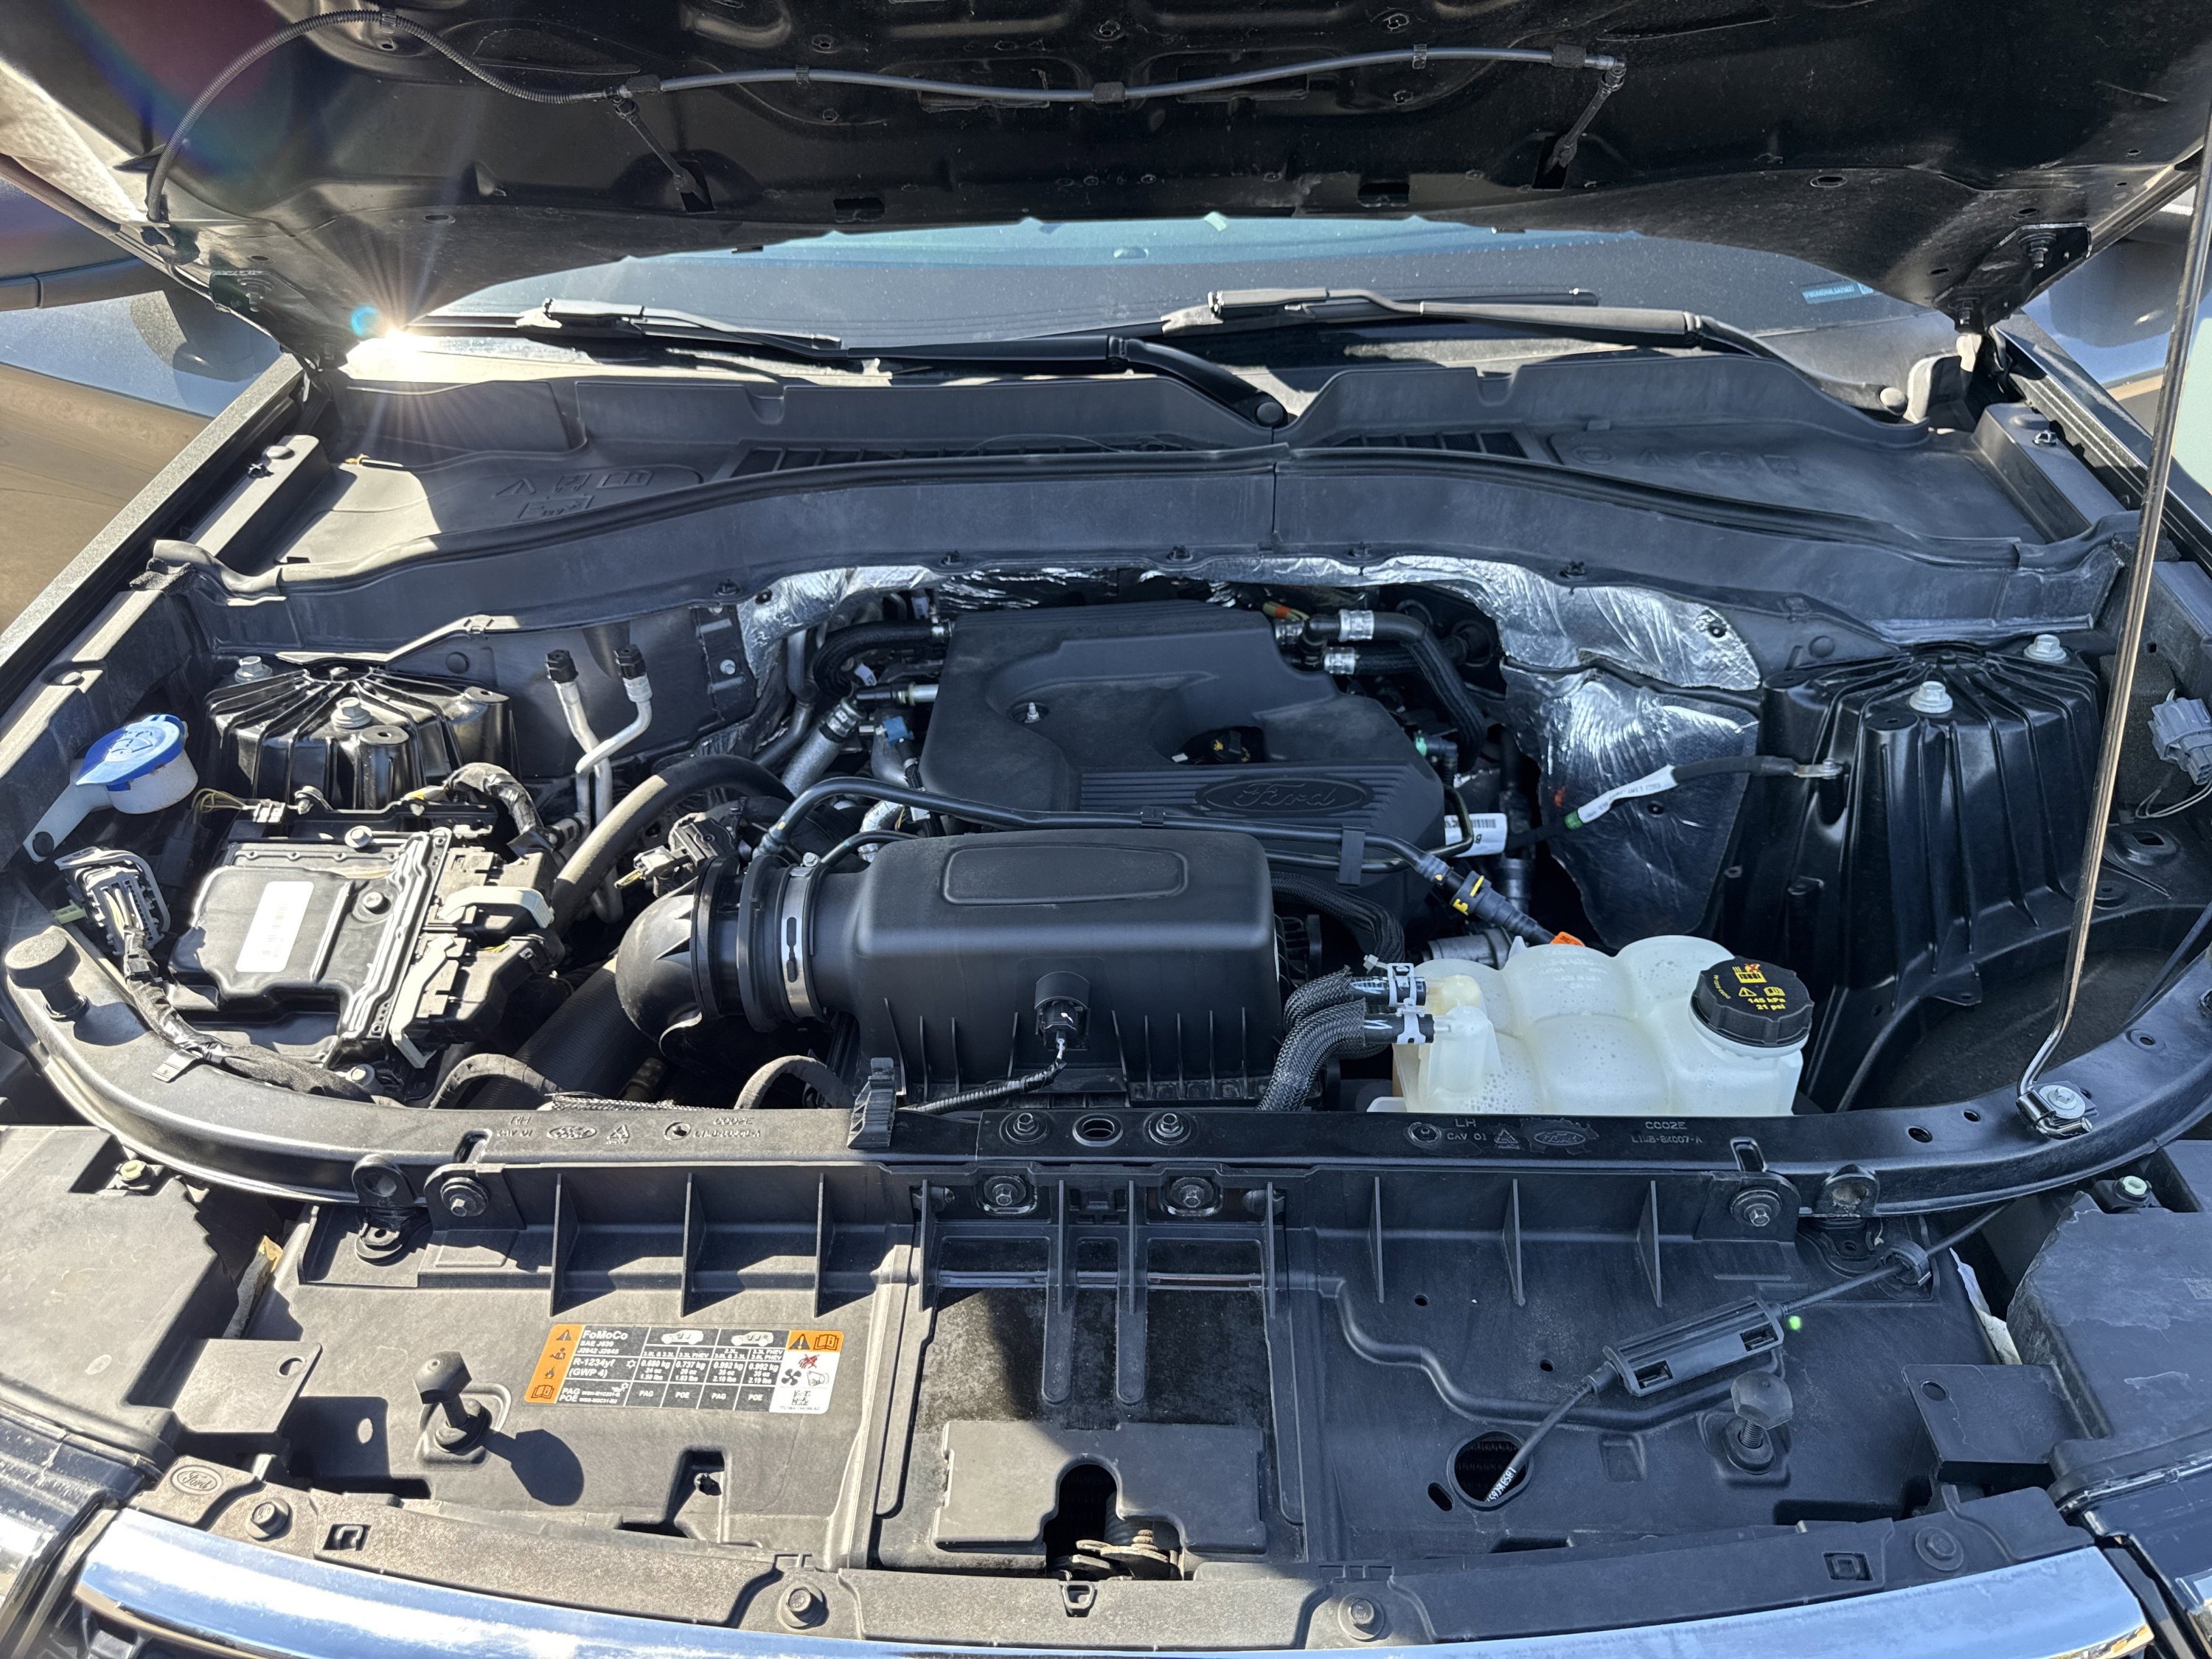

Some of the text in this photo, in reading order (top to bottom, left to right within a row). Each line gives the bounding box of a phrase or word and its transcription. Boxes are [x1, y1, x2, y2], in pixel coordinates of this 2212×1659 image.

[1233, 782, 1337, 807] Ford
[1455, 1118, 1476, 1127] LH
[582, 1330, 628, 1340] FoMoCo
[573, 1358, 616, 1368] R-1234yf
[661, 1360, 671, 1368] kg
[696, 1362, 706, 1370] kg
[734, 1363, 743, 1371] kg
[769, 1364, 779, 1372] kg
[568, 1368, 608, 1378] (GWP 4)
[182, 1471, 212, 1489] Ford
